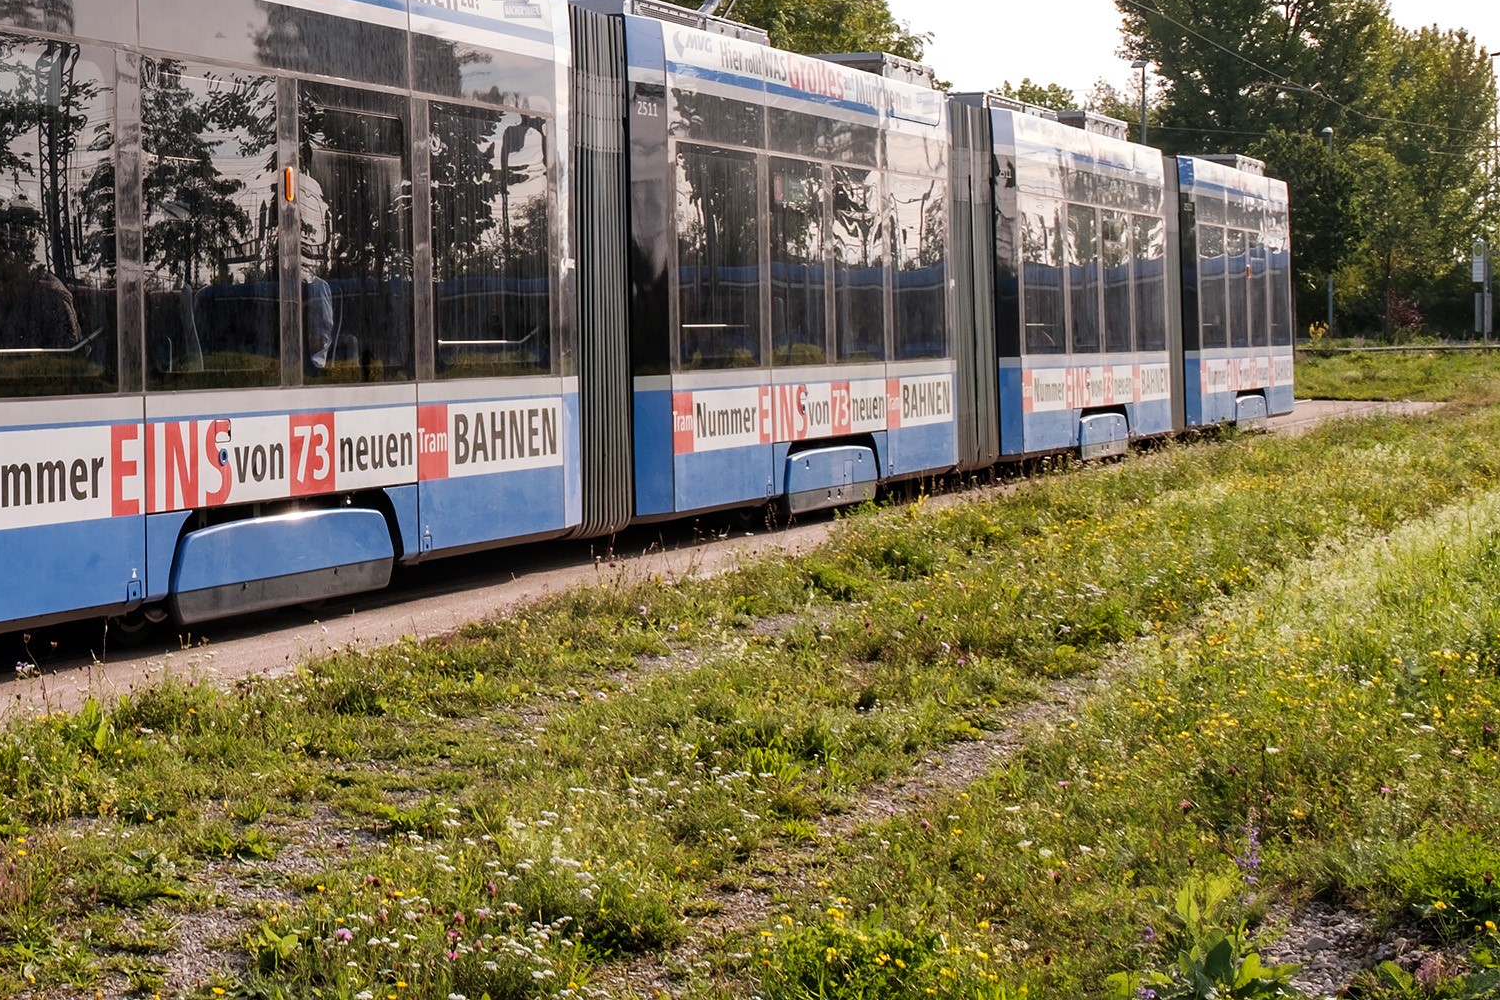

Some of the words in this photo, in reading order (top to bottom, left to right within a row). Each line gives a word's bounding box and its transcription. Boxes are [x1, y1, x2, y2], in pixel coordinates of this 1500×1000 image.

[685, 32, 713, 53] MVG
[719, 41, 743, 71] Hier
[745, 55, 762, 76] rollt
[764, 50, 788, 82] WAS
[788, 53, 846, 101] Großes
[637, 101, 658, 117] 2511
[1034, 378, 1064, 402] Nummer
[672, 411, 693, 432] Tram
[696, 402, 756, 438] Nummer
[759, 383, 808, 443] EINS
[808, 400, 830, 426] von
[832, 388, 849, 427] 73
[852, 396, 885, 421] neuen
[902, 381, 950, 419] BAHNEN
[110, 419, 233, 517] EINS
[234, 442, 284, 484] von
[293, 423, 330, 484] 73
[339, 431, 413, 474] neuen
[417, 427, 448, 454] Tram
[453, 406, 557, 465] BAHNEN
